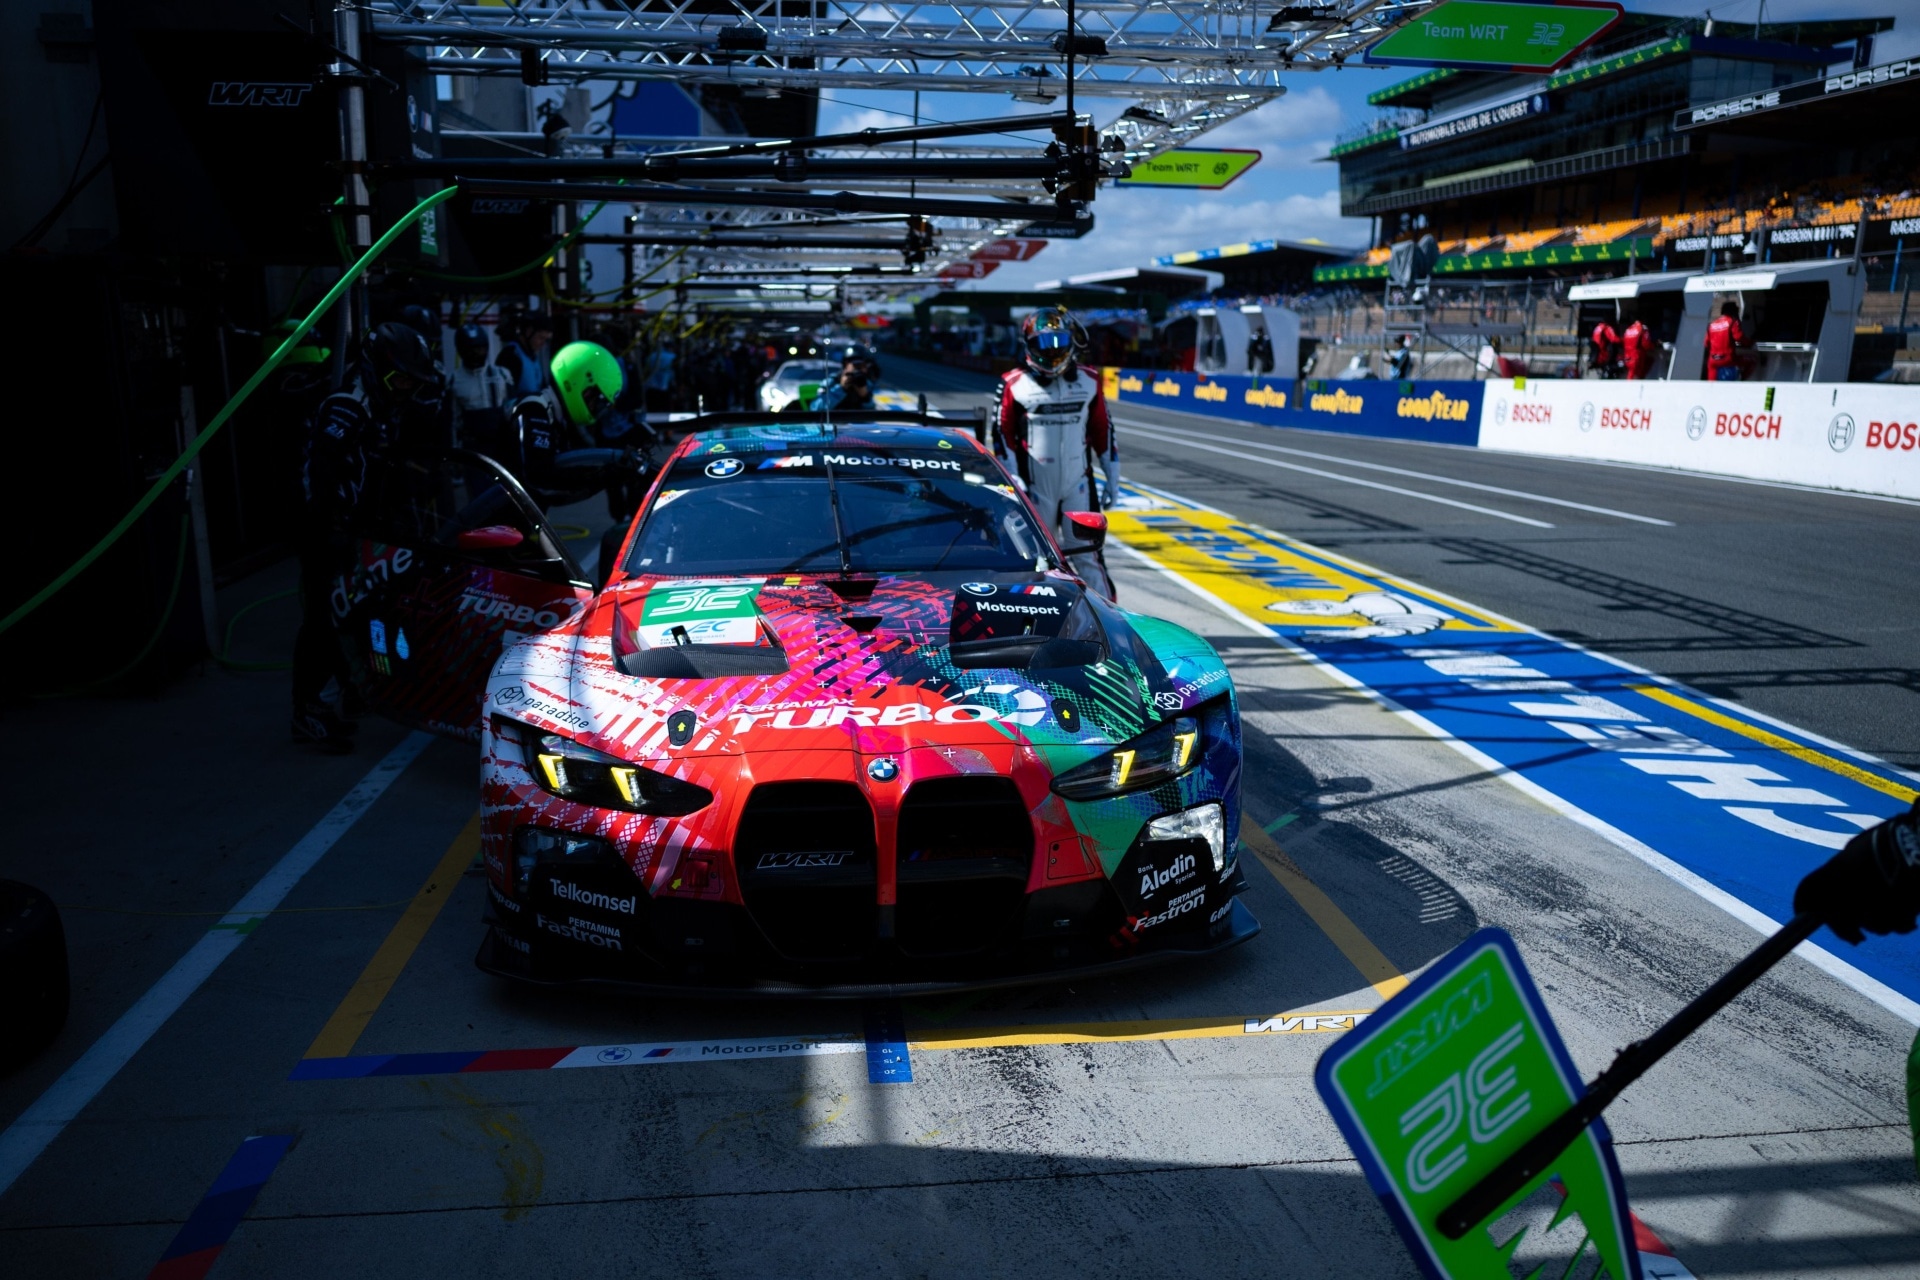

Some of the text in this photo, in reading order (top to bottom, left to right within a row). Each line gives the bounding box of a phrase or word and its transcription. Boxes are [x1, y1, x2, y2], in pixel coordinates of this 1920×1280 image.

[1422, 21, 1565, 45] Team WRT 32
[1824, 60, 1920, 94] PORSCH
[209, 82, 312, 105] WRT
[1692, 91, 1781, 124] PORSCHE
[1410, 122, 1456, 145] AUTOMOBILE
[1456, 115, 1479, 133] CLUB
[1480, 111, 1492, 127] DE
[1146, 162, 1174, 173] Team
[1175, 162, 1200, 174] WRT
[1890, 218, 1920, 236] RACE
[1397, 390, 1470, 422] GOODYEAR
[1512, 404, 1552, 424] BOSCH
[1601, 408, 1652, 430] BOSCH
[1715, 412, 1781, 440] BOSCH
[1866, 421, 1920, 451] BOS
[823, 455, 961, 471] Motorsport
[465, 586, 511, 601] PERTAMAX
[648, 586, 754, 617] 32
[457, 595, 560, 628] TURBO
[976, 602, 1060, 615] Motorsport
[1179, 668, 1229, 697] paradine
[521, 697, 590, 728] paradine
[728, 698, 857, 713] PERTAMAX
[727, 703, 998, 736] TURBO
[1402, 648, 1890, 850] CHELIN
[756, 851, 854, 869] WRT
[1138, 863, 1154, 874] Bank
[1140, 853, 1196, 896] Aladin
[1175, 870, 1196, 885] Syariah
[549, 877, 637, 915] Telkomsel
[1168, 885, 1206, 908] PERTAMINA
[1133, 893, 1205, 932] Fastron
[535, 913, 625, 952] Fastron
[568, 916, 621, 938] PERTAMINA
[1244, 1013, 1371, 1033] WRT
[701, 1040, 822, 1057] Motorsport
[1399, 1020, 1533, 1188] 32
